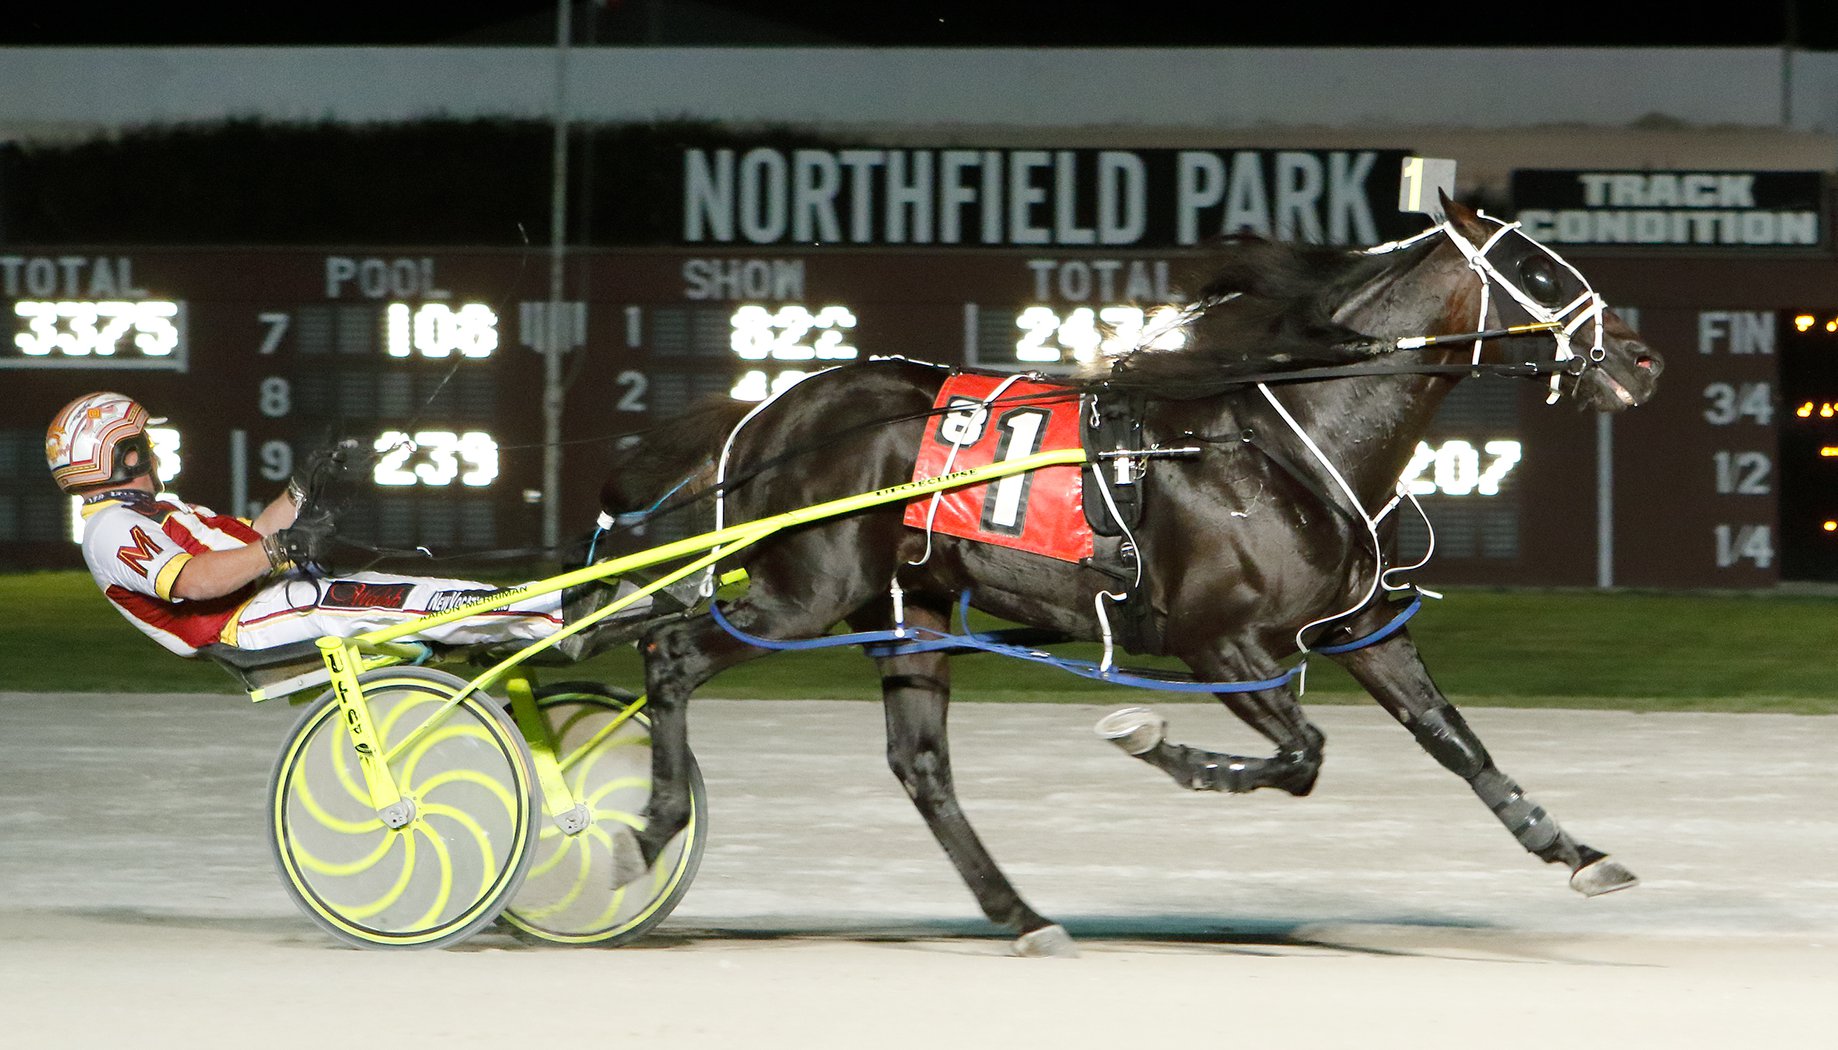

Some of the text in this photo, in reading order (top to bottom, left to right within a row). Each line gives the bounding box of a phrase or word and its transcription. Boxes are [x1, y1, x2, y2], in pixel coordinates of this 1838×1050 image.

[683, 148, 1378, 246] NORTHFIELD PARK
[1404, 157, 1424, 212] 1
[1577, 174, 1756, 207] TRACK
[1517, 209, 1819, 245] CONDITION
[0, 256, 148, 297] TOTAL
[325, 257, 451, 299] POOL
[1028, 260, 1184, 301] TOTAL
[15, 301, 179, 356] 3375
[258, 313, 290, 354] 7
[624, 306, 642, 347] 1
[730, 305, 858, 360] 822
[1698, 311, 1777, 354] FIN
[259, 376, 290, 417] 8
[616, 370, 649, 412] 2
[939, 397, 990, 447] 8
[261, 440, 293, 480] 9
[373, 431, 498, 486] 239
[986, 408, 1047, 532] 1
[1713, 450, 1771, 495] 1/2
[116, 525, 164, 579] M
[1714, 524, 1774, 568] 1/4
